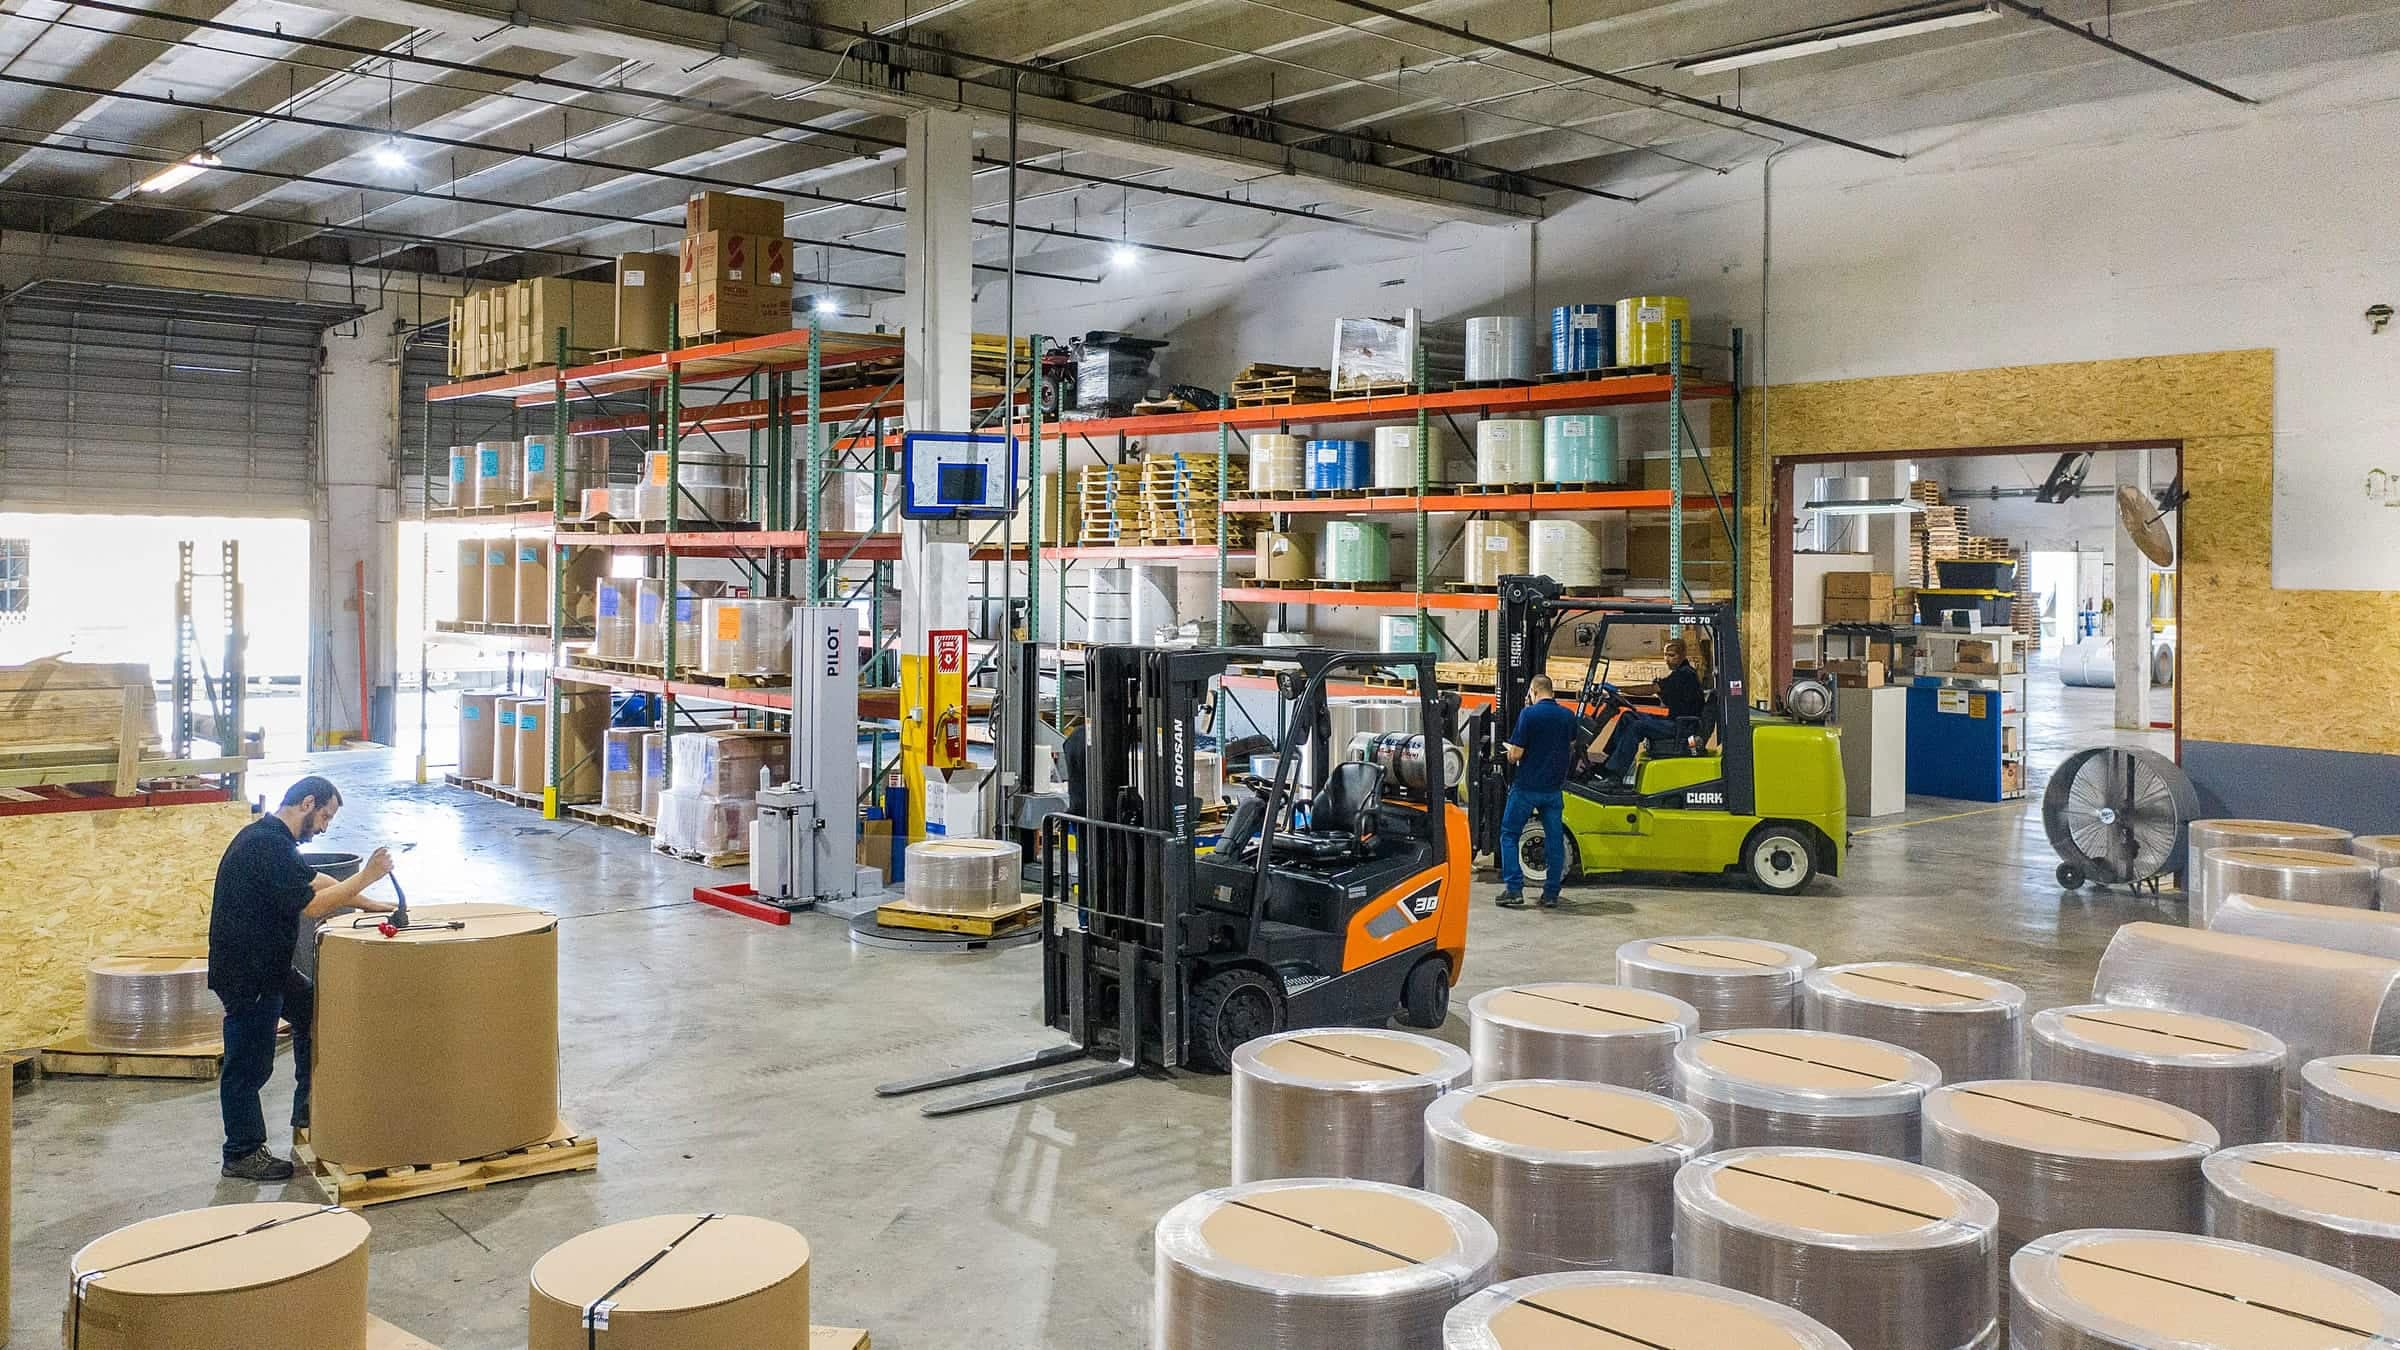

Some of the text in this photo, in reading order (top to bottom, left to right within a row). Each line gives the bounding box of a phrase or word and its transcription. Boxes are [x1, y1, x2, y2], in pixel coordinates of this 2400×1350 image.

[1679, 616, 1711, 624] CGC 70
[827, 626, 839, 676] PILOT
[1511, 632, 1521, 667] CLARK
[1174, 718, 1184, 788] DOOSAN
[1686, 792, 1723, 804] CLARK
[1414, 896, 1439, 912] 30
